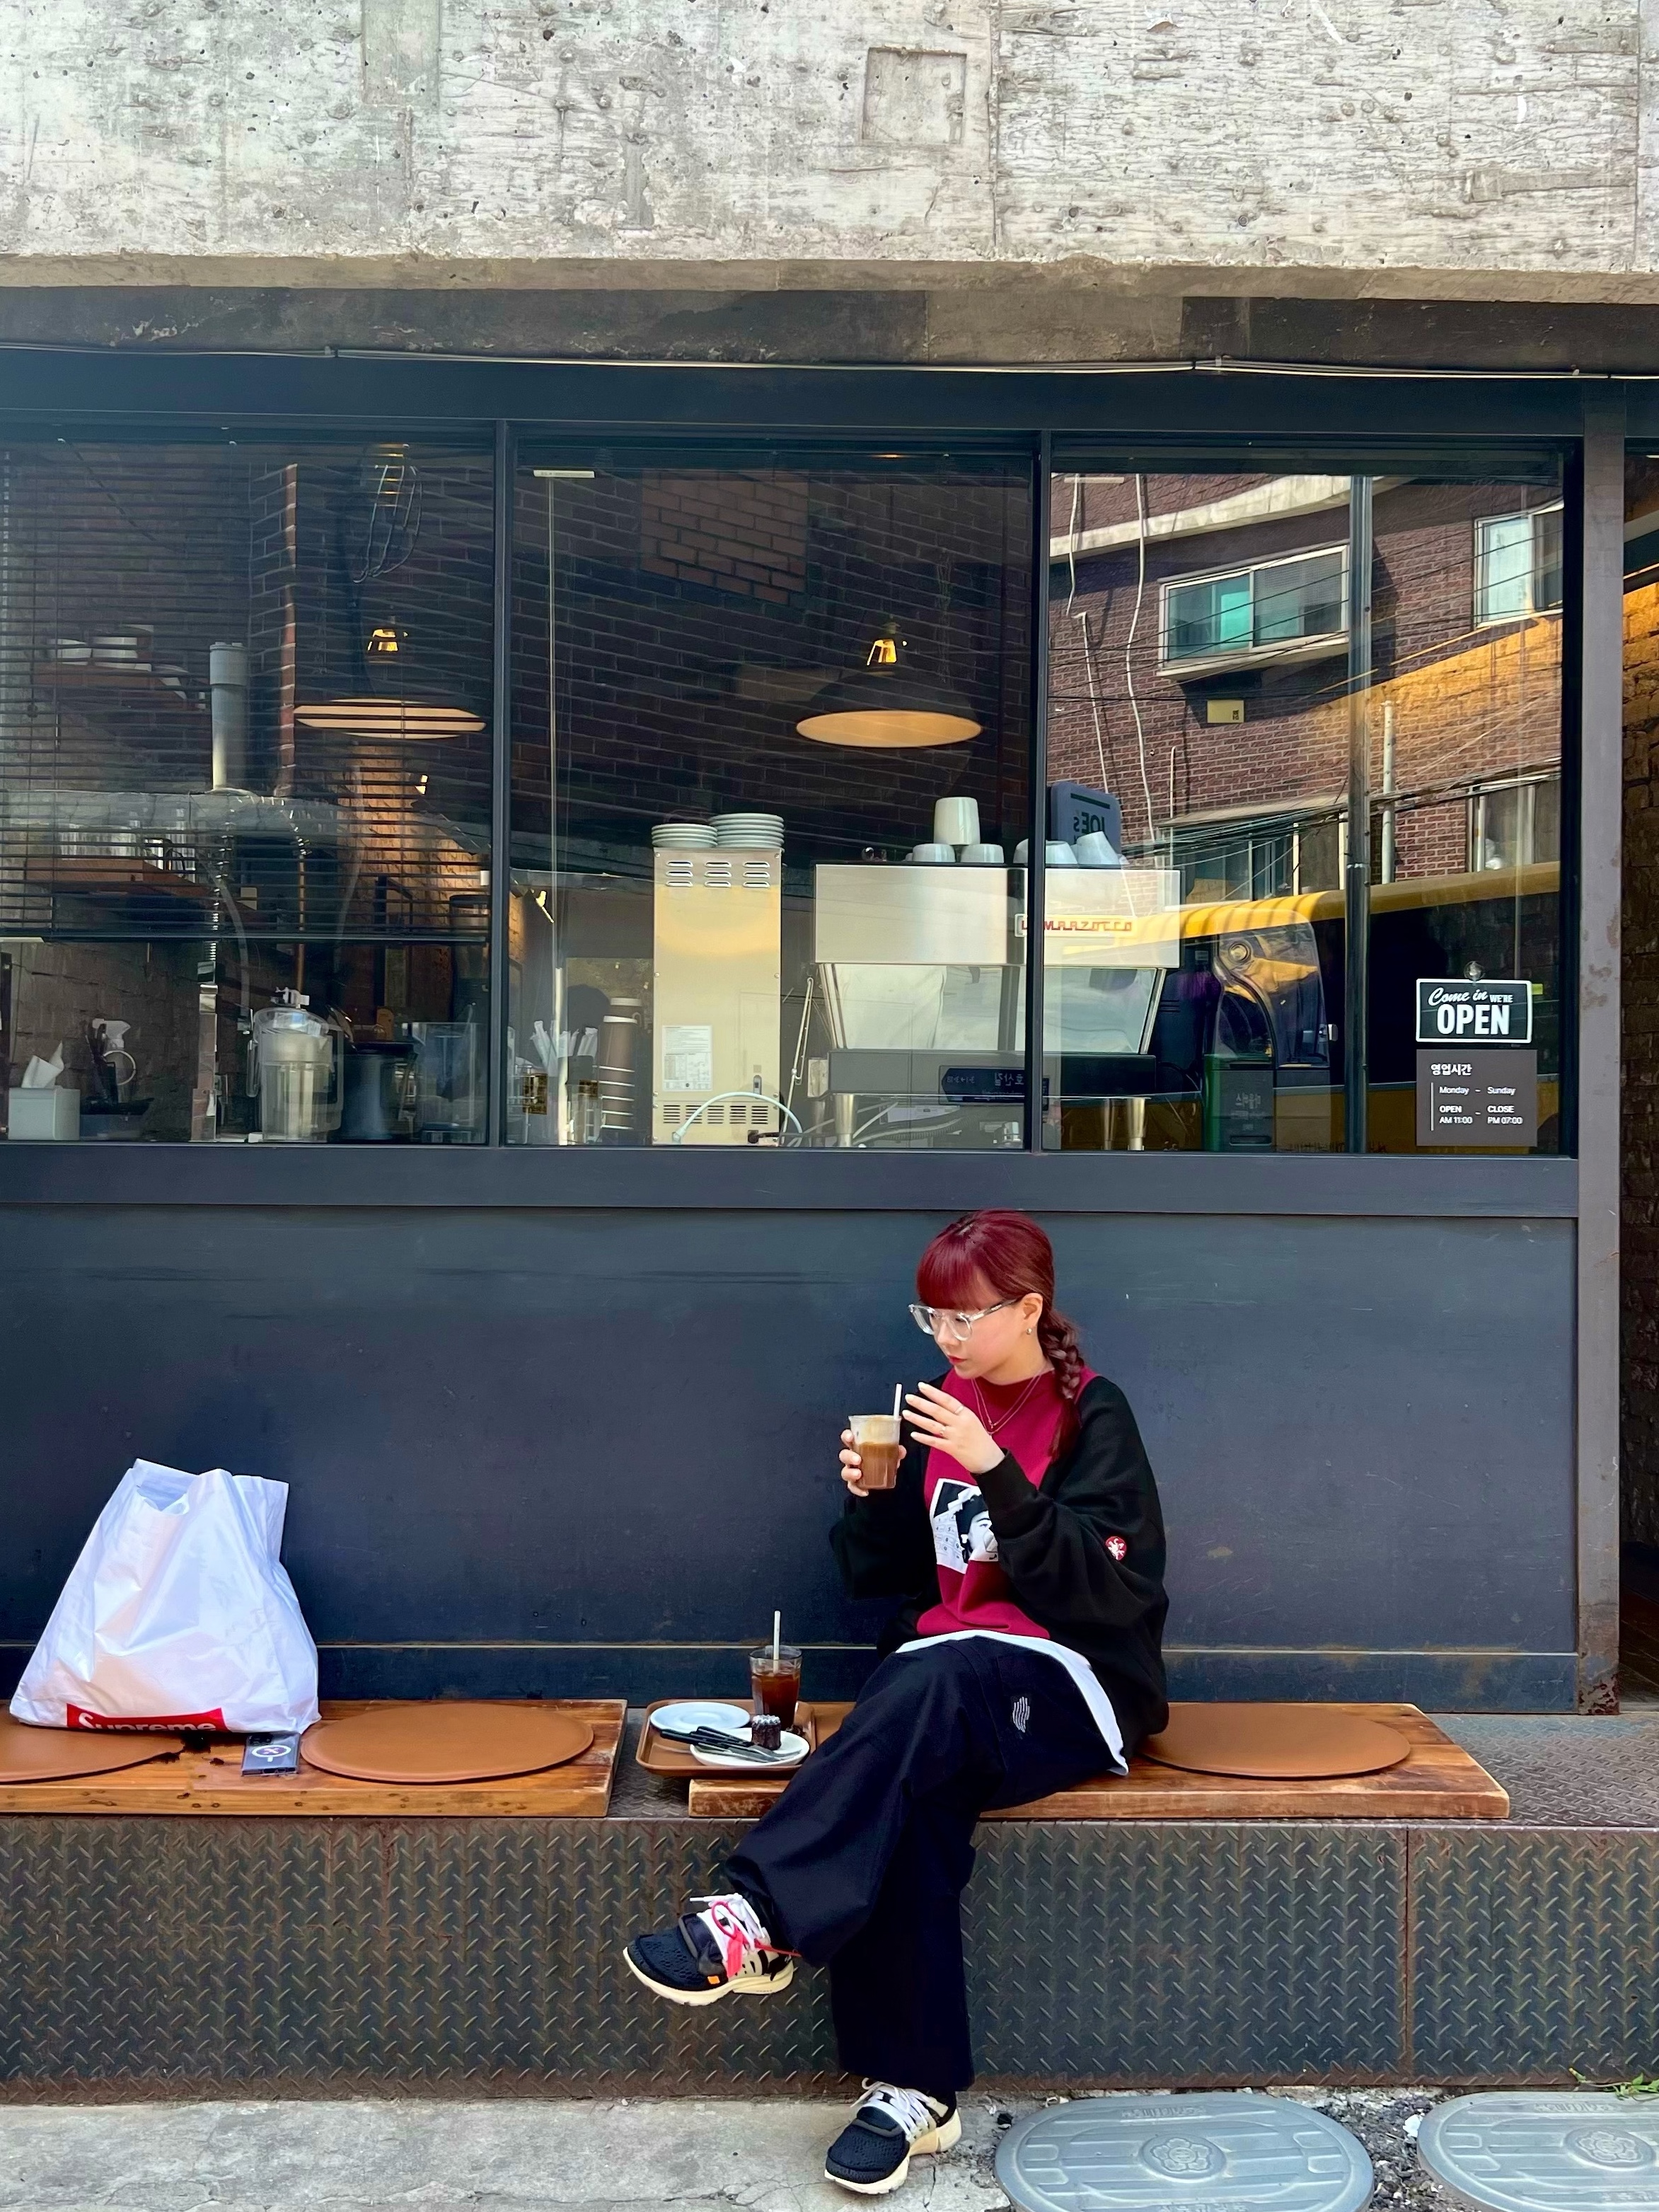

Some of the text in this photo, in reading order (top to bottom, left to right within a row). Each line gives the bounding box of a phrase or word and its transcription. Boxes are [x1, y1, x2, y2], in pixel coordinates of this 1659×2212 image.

[1428, 986, 1513, 1006] Come in WE'RE
[1437, 1003, 1510, 1035] OPEN
[1430, 1064, 1473, 1076] 영업시간
[1438, 1086, 1470, 1095] Monday
[1487, 1086, 1516, 1096] Sunday
